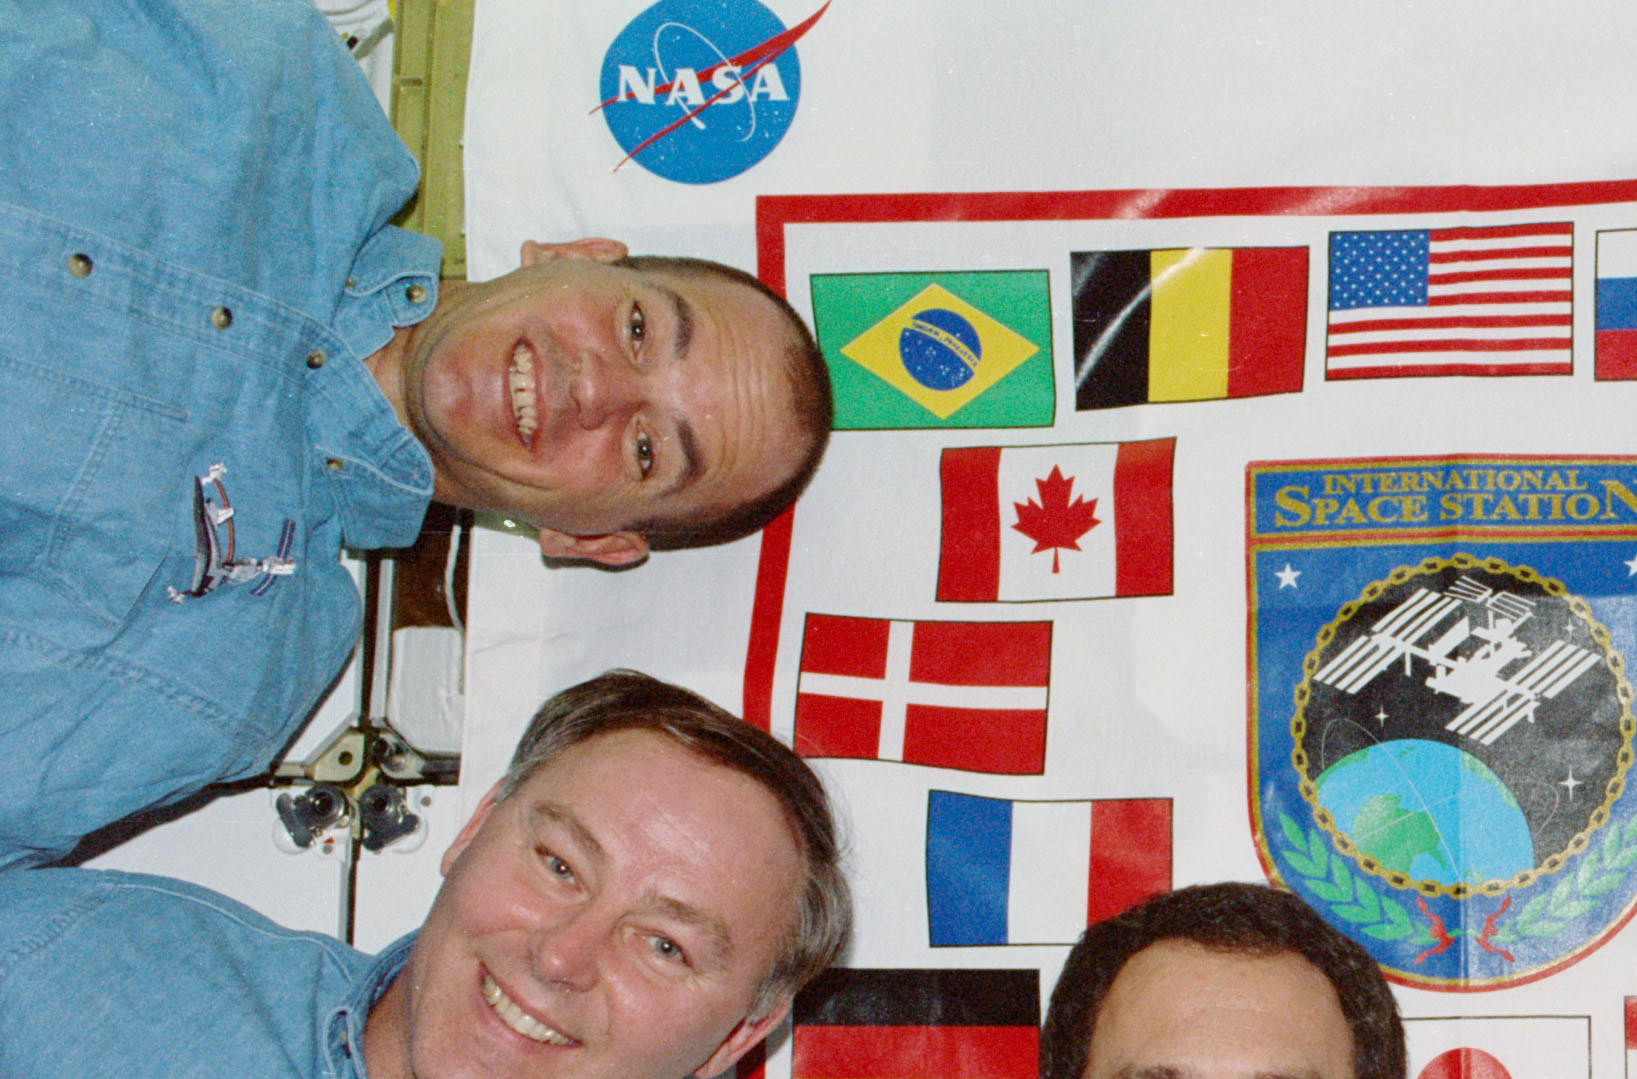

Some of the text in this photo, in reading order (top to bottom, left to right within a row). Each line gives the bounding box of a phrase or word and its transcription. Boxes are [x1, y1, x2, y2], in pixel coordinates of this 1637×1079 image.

[618, 63, 789, 105] NASA
[1322, 469, 1588, 496] INTERNATIONAL
[1274, 485, 1428, 528] SPACE
